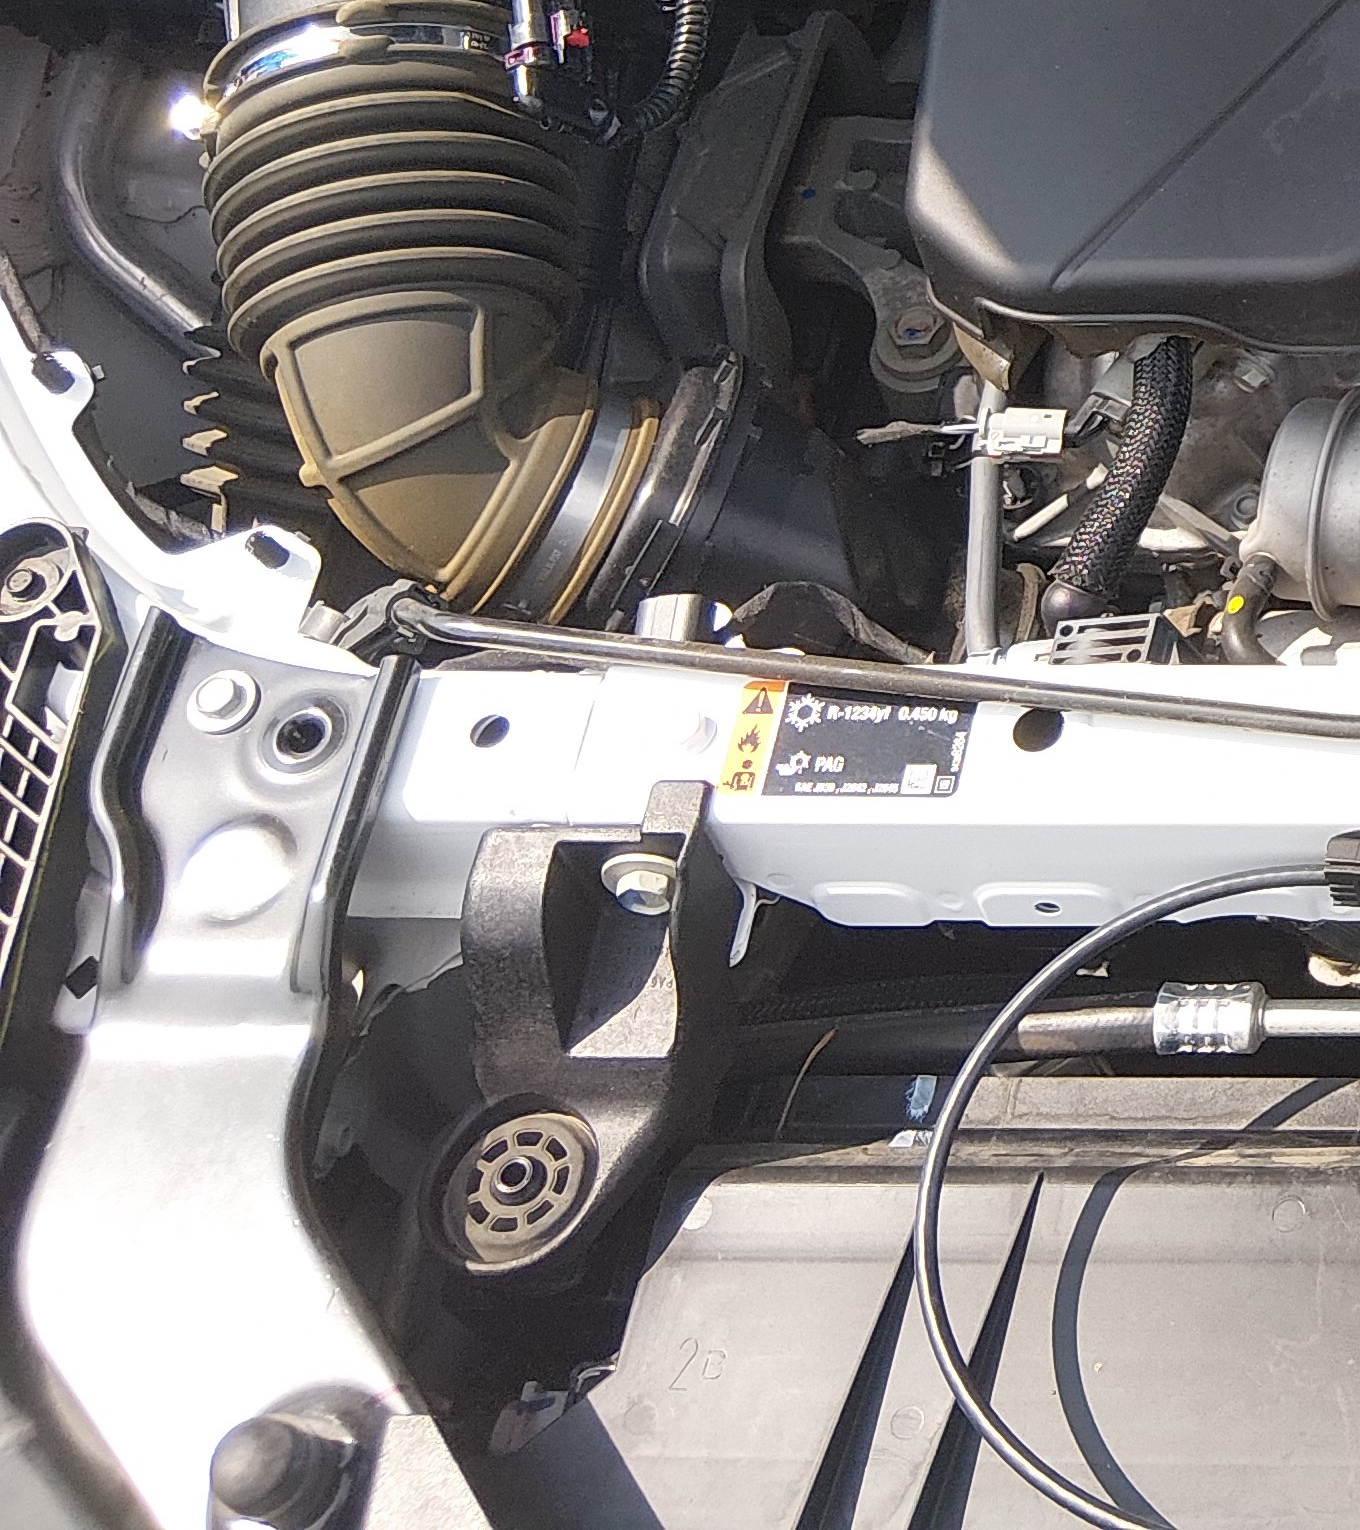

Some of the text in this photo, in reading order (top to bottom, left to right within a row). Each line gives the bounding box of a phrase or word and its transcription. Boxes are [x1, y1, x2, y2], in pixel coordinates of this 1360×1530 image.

[826, 706, 959, 725] R-1234yf 0.450 kg
[815, 756, 845, 773] PAG
